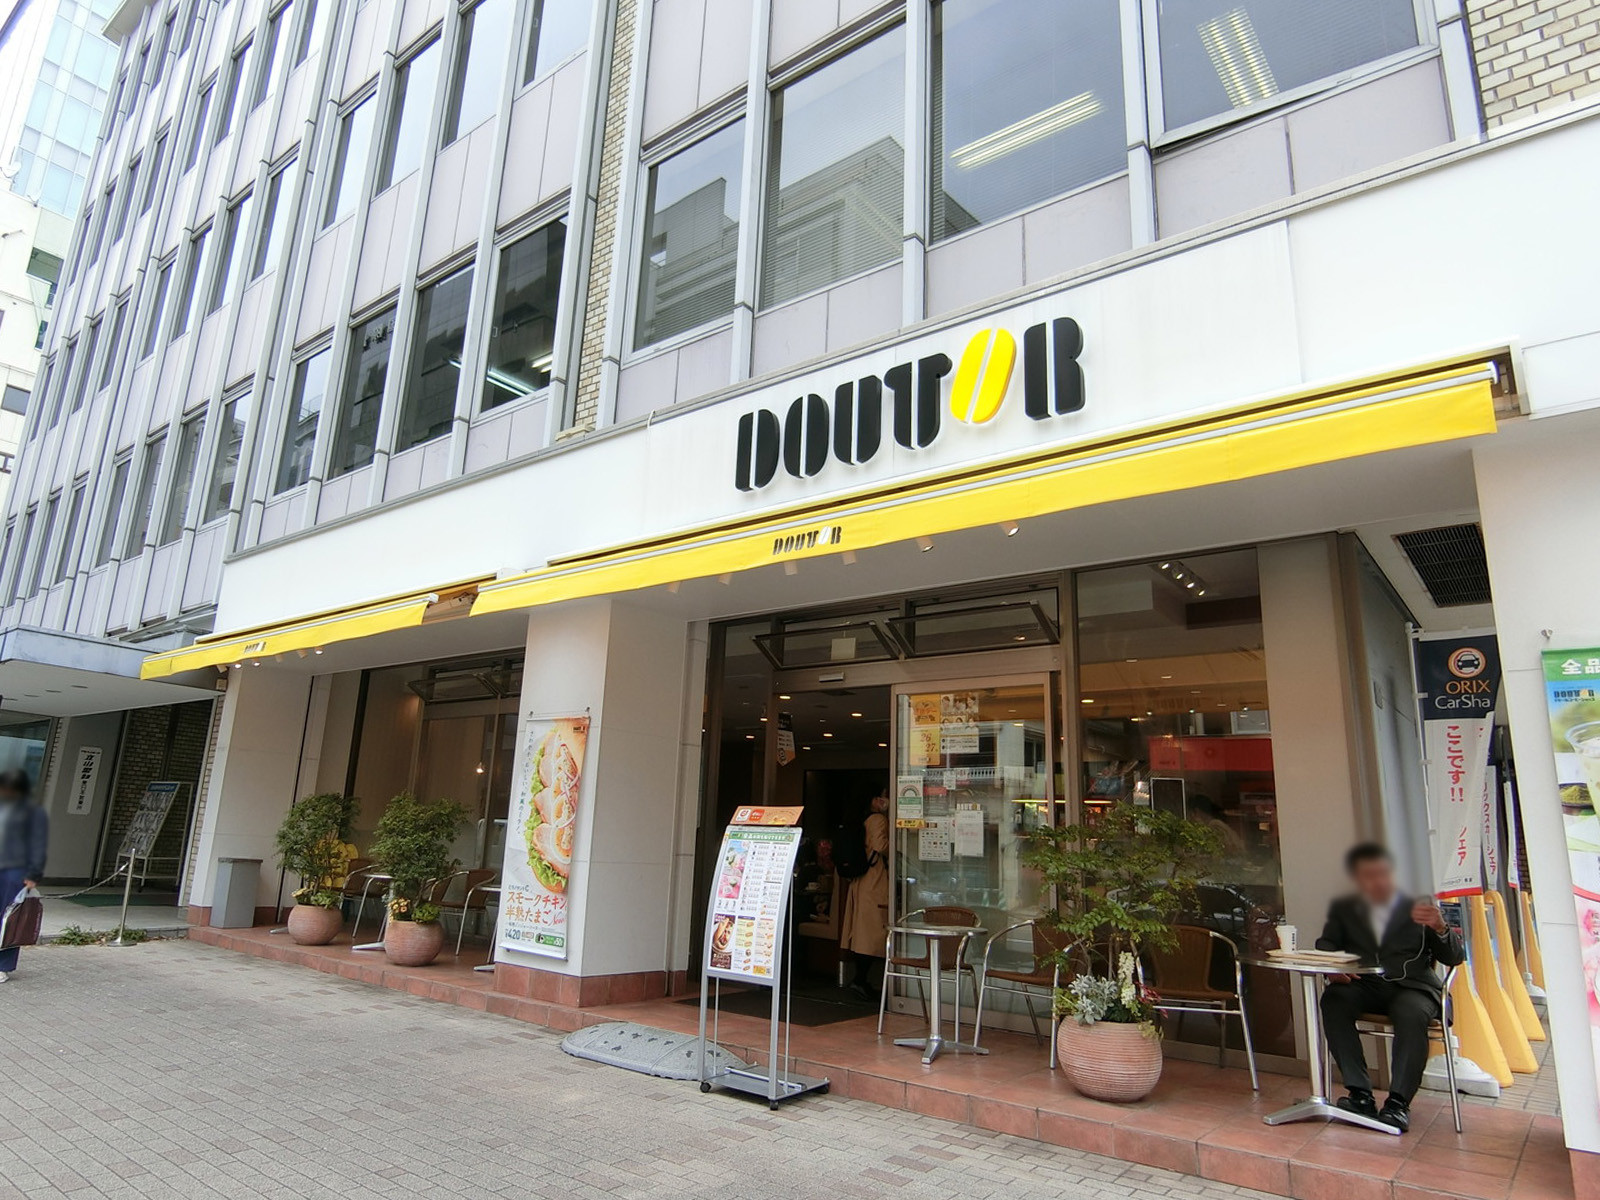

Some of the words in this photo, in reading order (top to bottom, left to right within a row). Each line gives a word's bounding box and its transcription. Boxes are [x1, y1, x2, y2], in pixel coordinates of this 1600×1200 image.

[735, 316, 1086, 493] DOUTOR
[773, 526, 842, 555] DOUTOR
[1446, 680, 1491, 694] ORIX
[1435, 694, 1491, 709] CarSha
